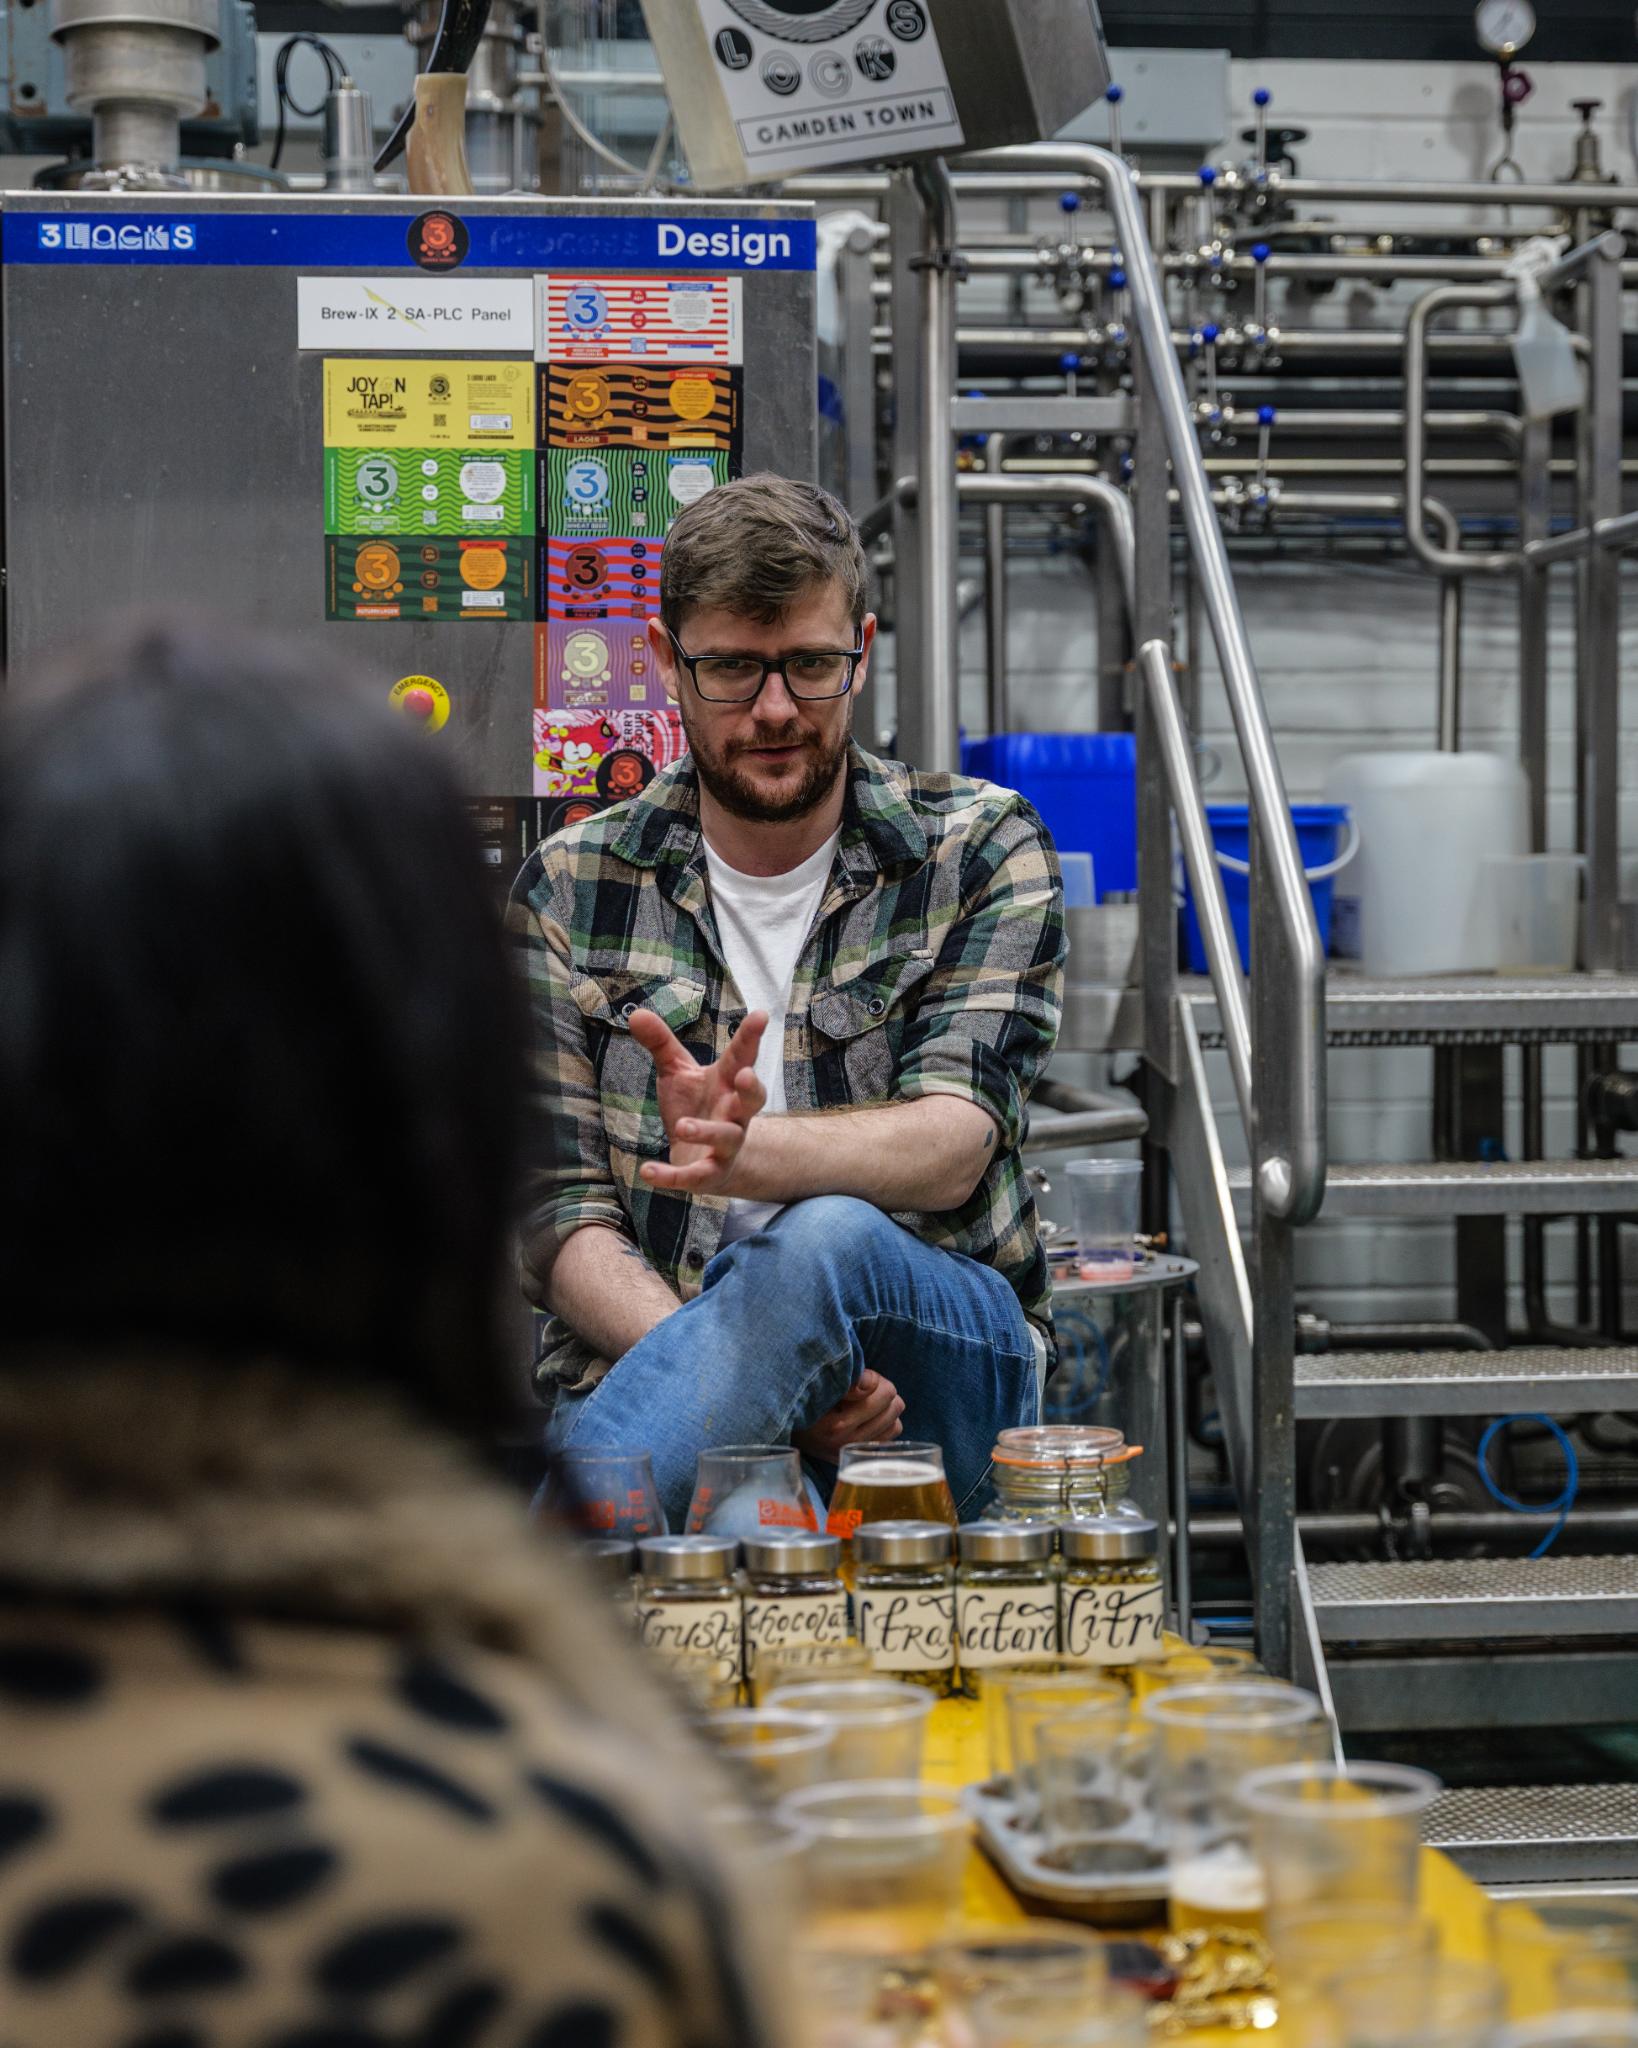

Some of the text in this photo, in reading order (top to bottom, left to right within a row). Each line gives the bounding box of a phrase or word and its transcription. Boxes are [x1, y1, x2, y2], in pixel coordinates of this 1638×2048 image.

[756, 102, 936, 146] CAMDEN TOWN
[429, 223, 447, 245] 3
[657, 224, 791, 265] Design
[321, 306, 511, 321] Brew-IX 2 SA-PLC Panel
[574, 295, 598, 324] 3
[347, 376, 378, 393] JOY
[434, 379, 446, 394] 3
[575, 382, 600, 412] 3
[360, 393, 393, 409] TAP!
[365, 467, 390, 496] 3
[575, 469, 599, 498] 3
[365, 553, 390, 584] 3
[574, 555, 599, 584] 3
[573, 641, 599, 672] 3
[617, 762, 635, 783] 3
[861, 1596, 955, 1661] Stra
